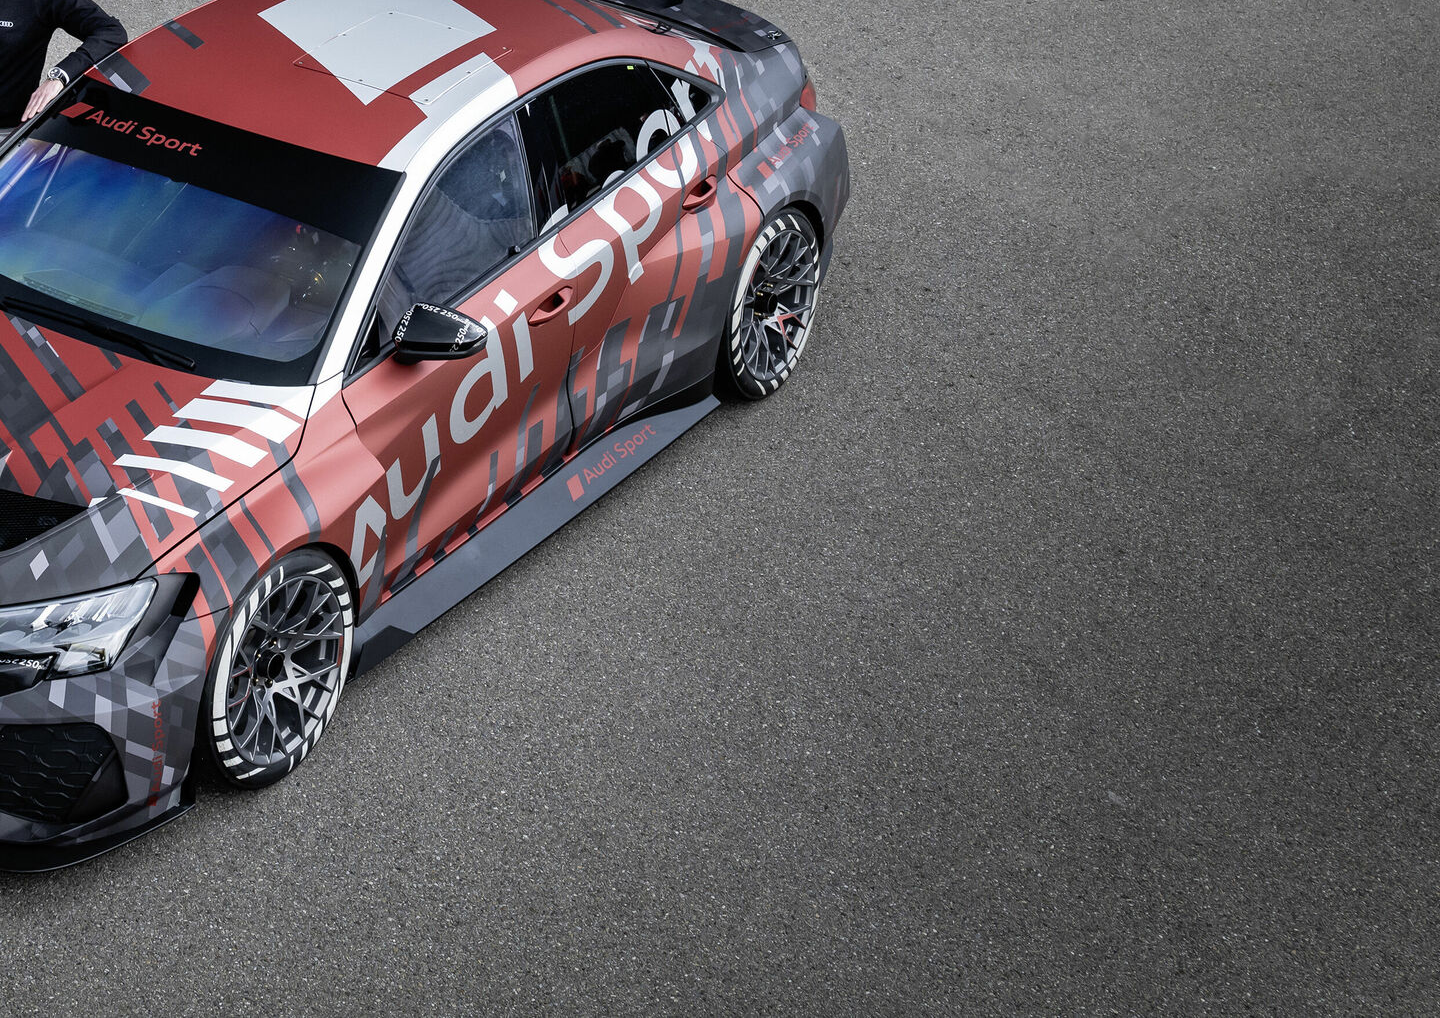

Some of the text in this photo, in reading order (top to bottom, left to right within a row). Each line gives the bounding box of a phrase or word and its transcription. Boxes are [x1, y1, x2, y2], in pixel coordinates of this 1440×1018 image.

[85, 109, 203, 157] Audi Sport
[768, 122, 816, 167] Audi Sport
[349, 289, 534, 589] Audi
[583, 423, 657, 485] Audi Sport
[151, 698, 166, 792] Audi Sport
